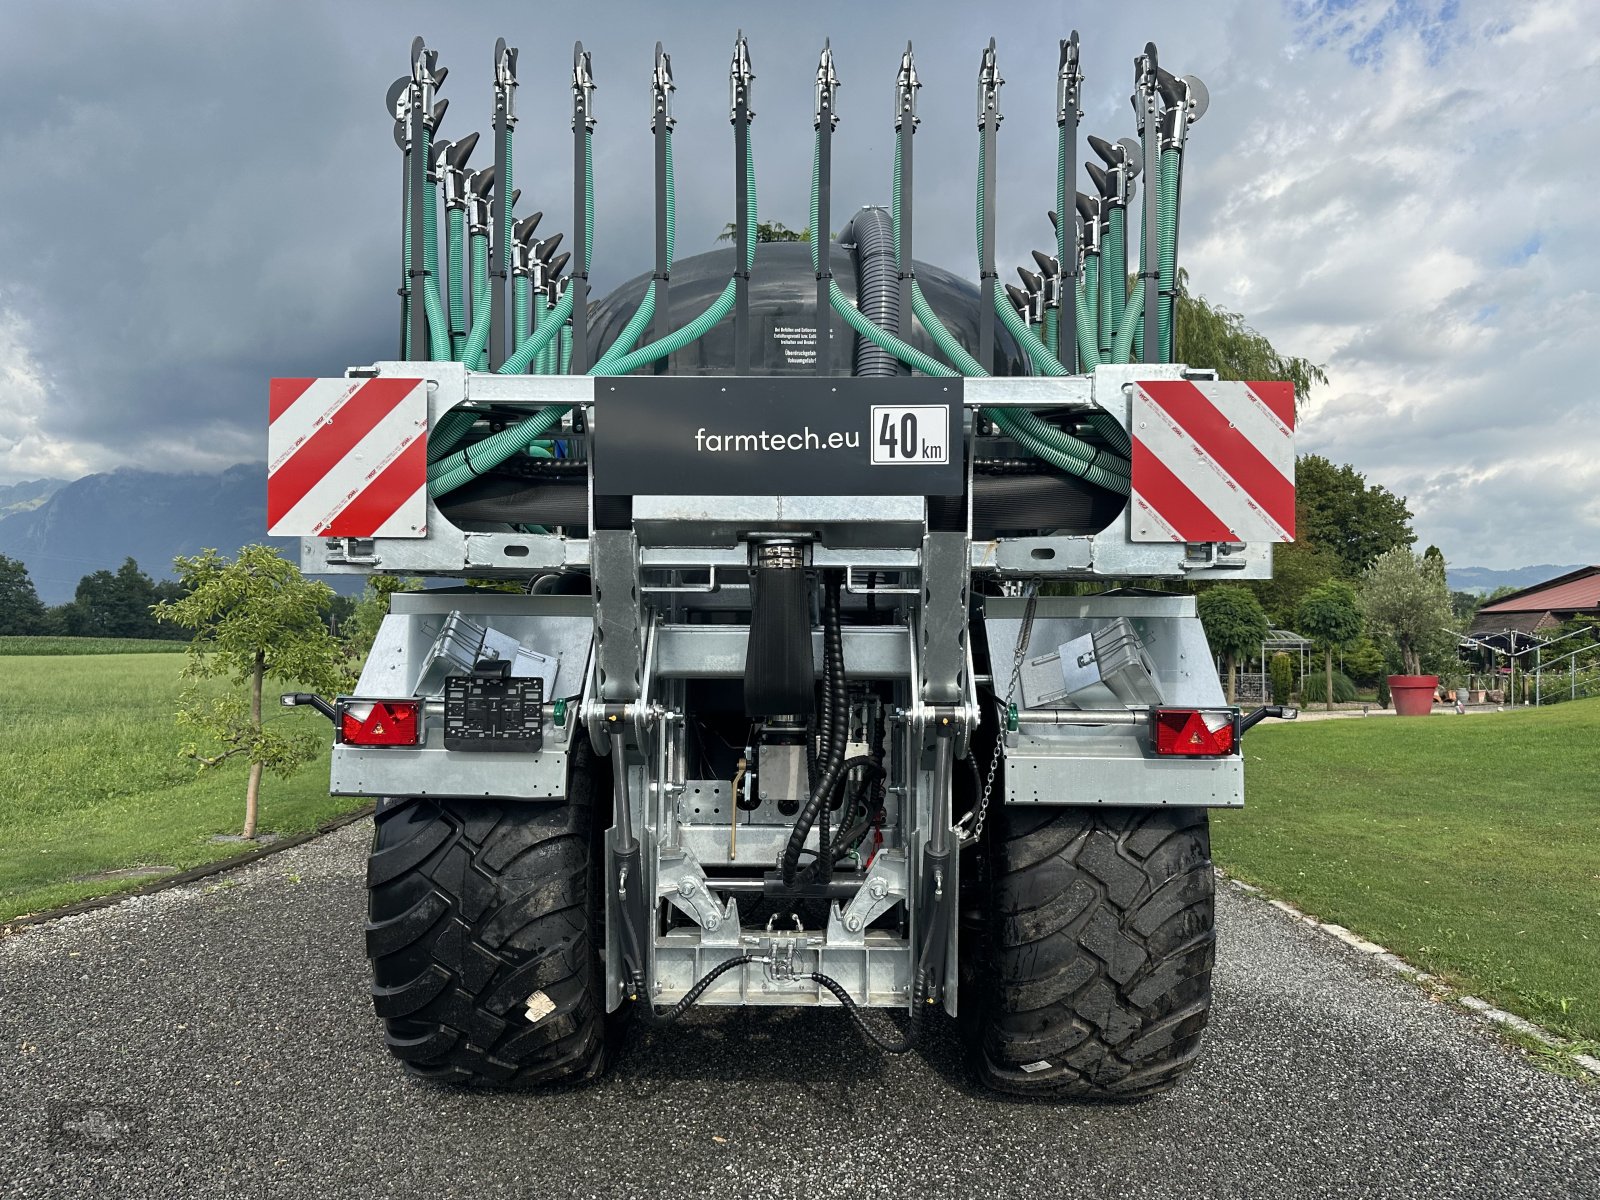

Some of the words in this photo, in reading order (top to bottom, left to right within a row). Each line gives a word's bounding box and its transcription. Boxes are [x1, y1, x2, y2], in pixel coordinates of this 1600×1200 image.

[785, 349, 816, 357] Überdruckgefah
[694, 426, 860, 452] farmtech.eu
[879, 412, 918, 459] 40
[922, 438, 942, 459] km
